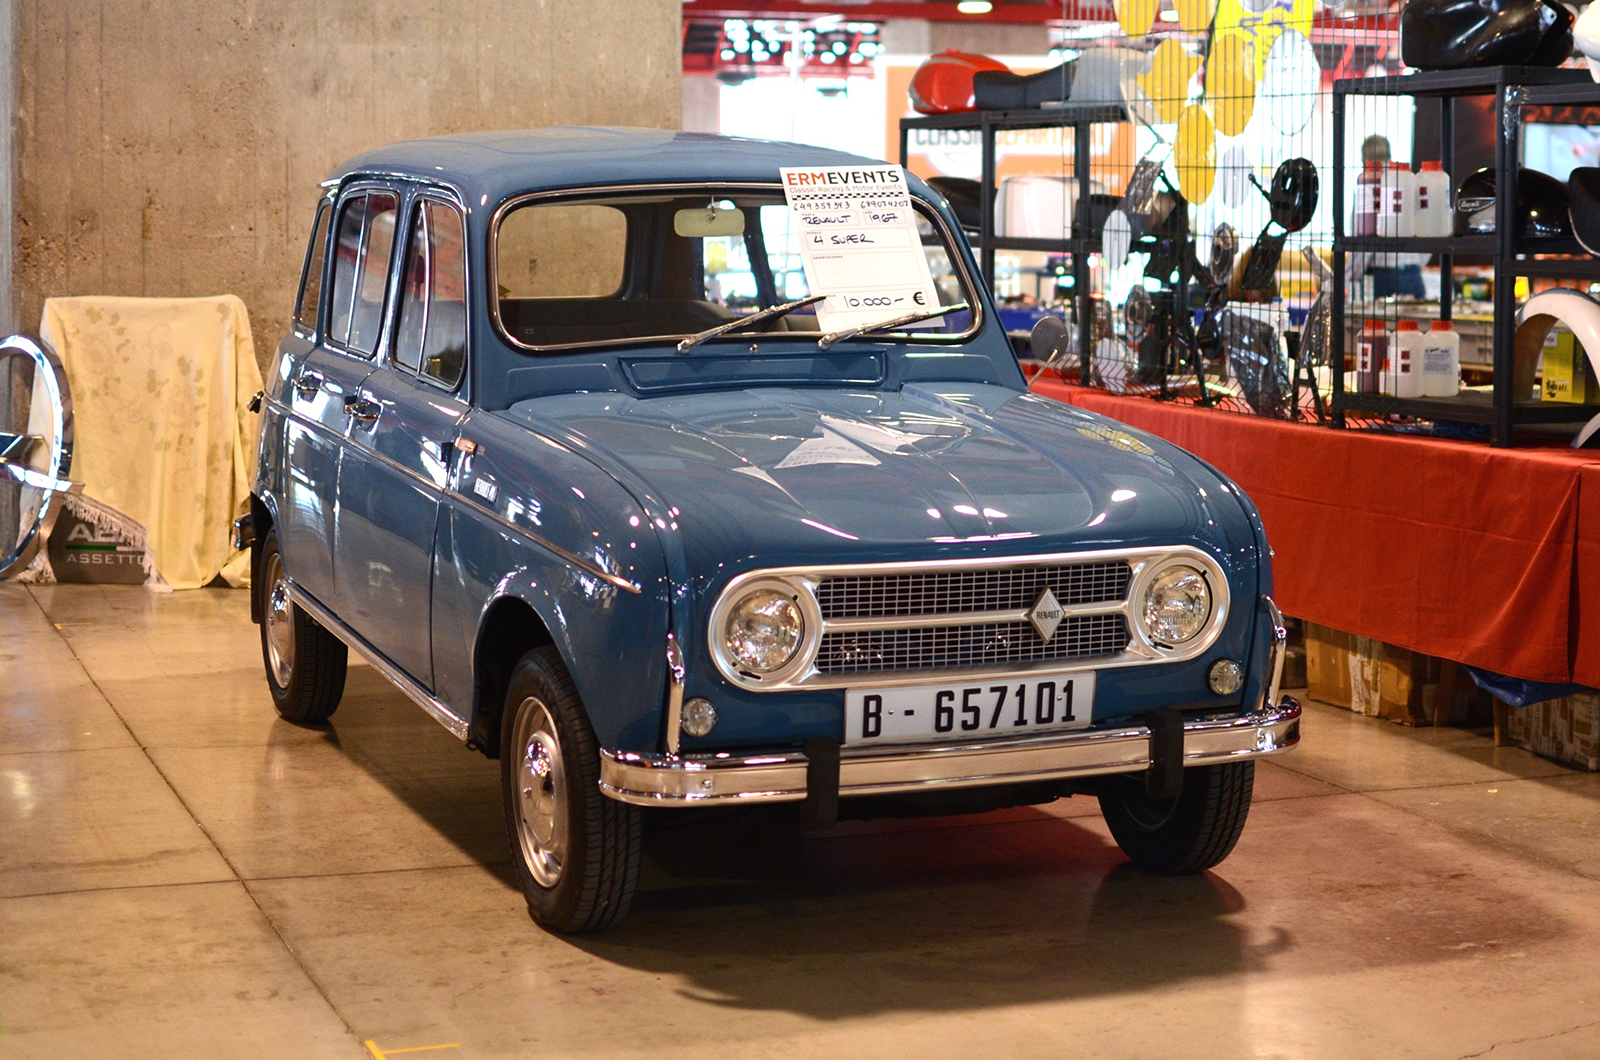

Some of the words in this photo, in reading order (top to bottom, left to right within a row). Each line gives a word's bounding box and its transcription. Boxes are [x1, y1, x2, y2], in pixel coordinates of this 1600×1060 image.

[789, 186, 817, 194] Classic
[818, 185, 844, 193] Racing
[875, 183, 903, 191] Events
[802, 214, 851, 225] RENAULT
[868, 212, 898, 223] 1967
[813, 235, 825, 245] 4
[830, 233, 875, 245] SUPER
[912, 291, 926, 306] €
[1036, 610, 1060, 620] RENAULT
[862, 694, 883, 738] B
[934, 680, 1076, 733] 657101
